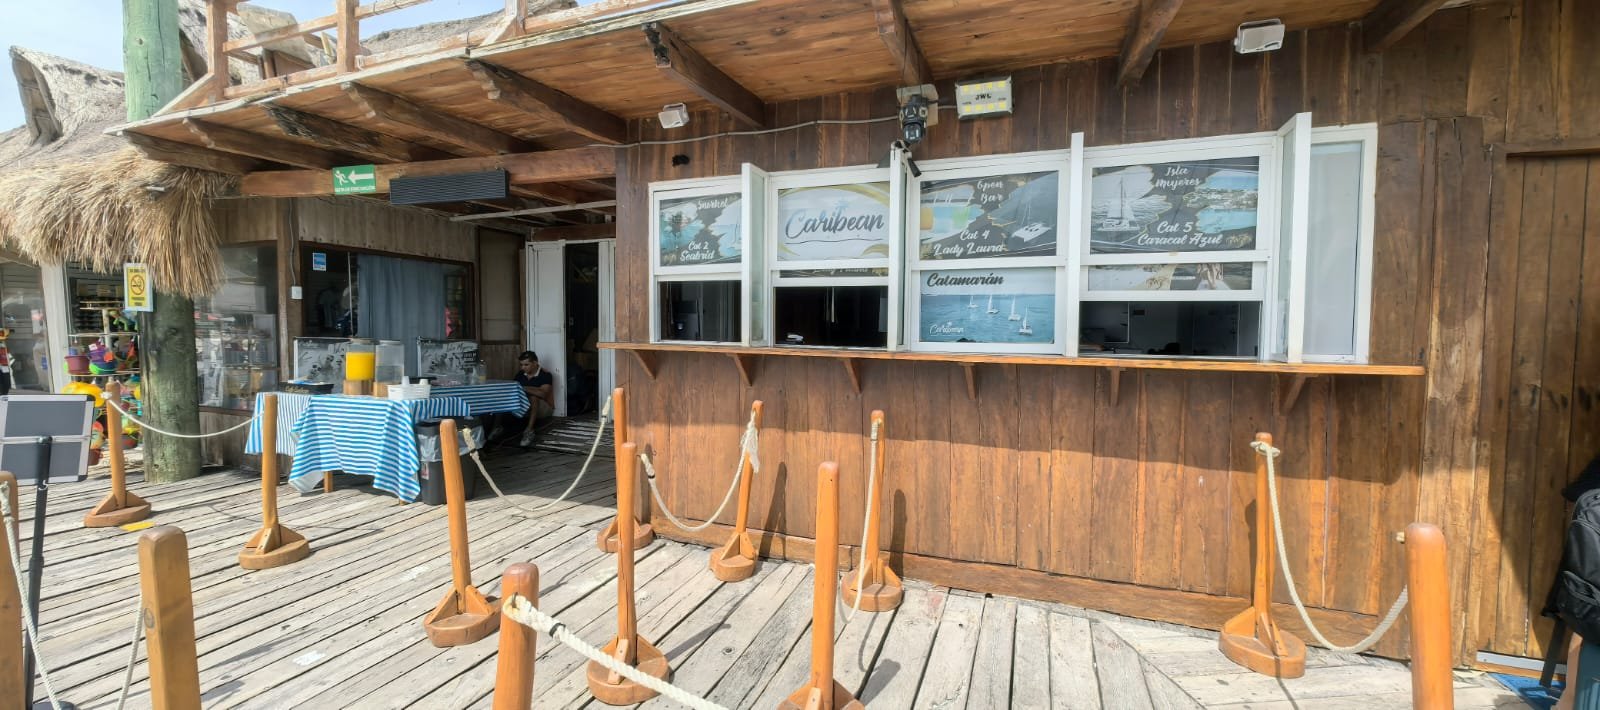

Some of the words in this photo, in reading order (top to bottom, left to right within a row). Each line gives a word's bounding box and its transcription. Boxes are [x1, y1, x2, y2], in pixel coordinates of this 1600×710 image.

[1165, 166, 1189, 176] Isla
[1155, 178, 1201, 190] Mujeres
[980, 193, 1003, 204] Bar
[785, 208, 884, 239] Caribean
[1183, 222, 1193, 232] 5
[960, 230, 978, 241] Cat
[981, 230, 990, 240] 4
[1138, 234, 1187, 246] Caracal
[1188, 233, 1223, 247] Azul
[688, 241, 702, 251] Cat
[703, 241, 709, 250] 2
[933, 244, 964, 257] Lady
[966, 242, 1004, 254] Laura
[927, 272, 1004, 287] Catamarán
